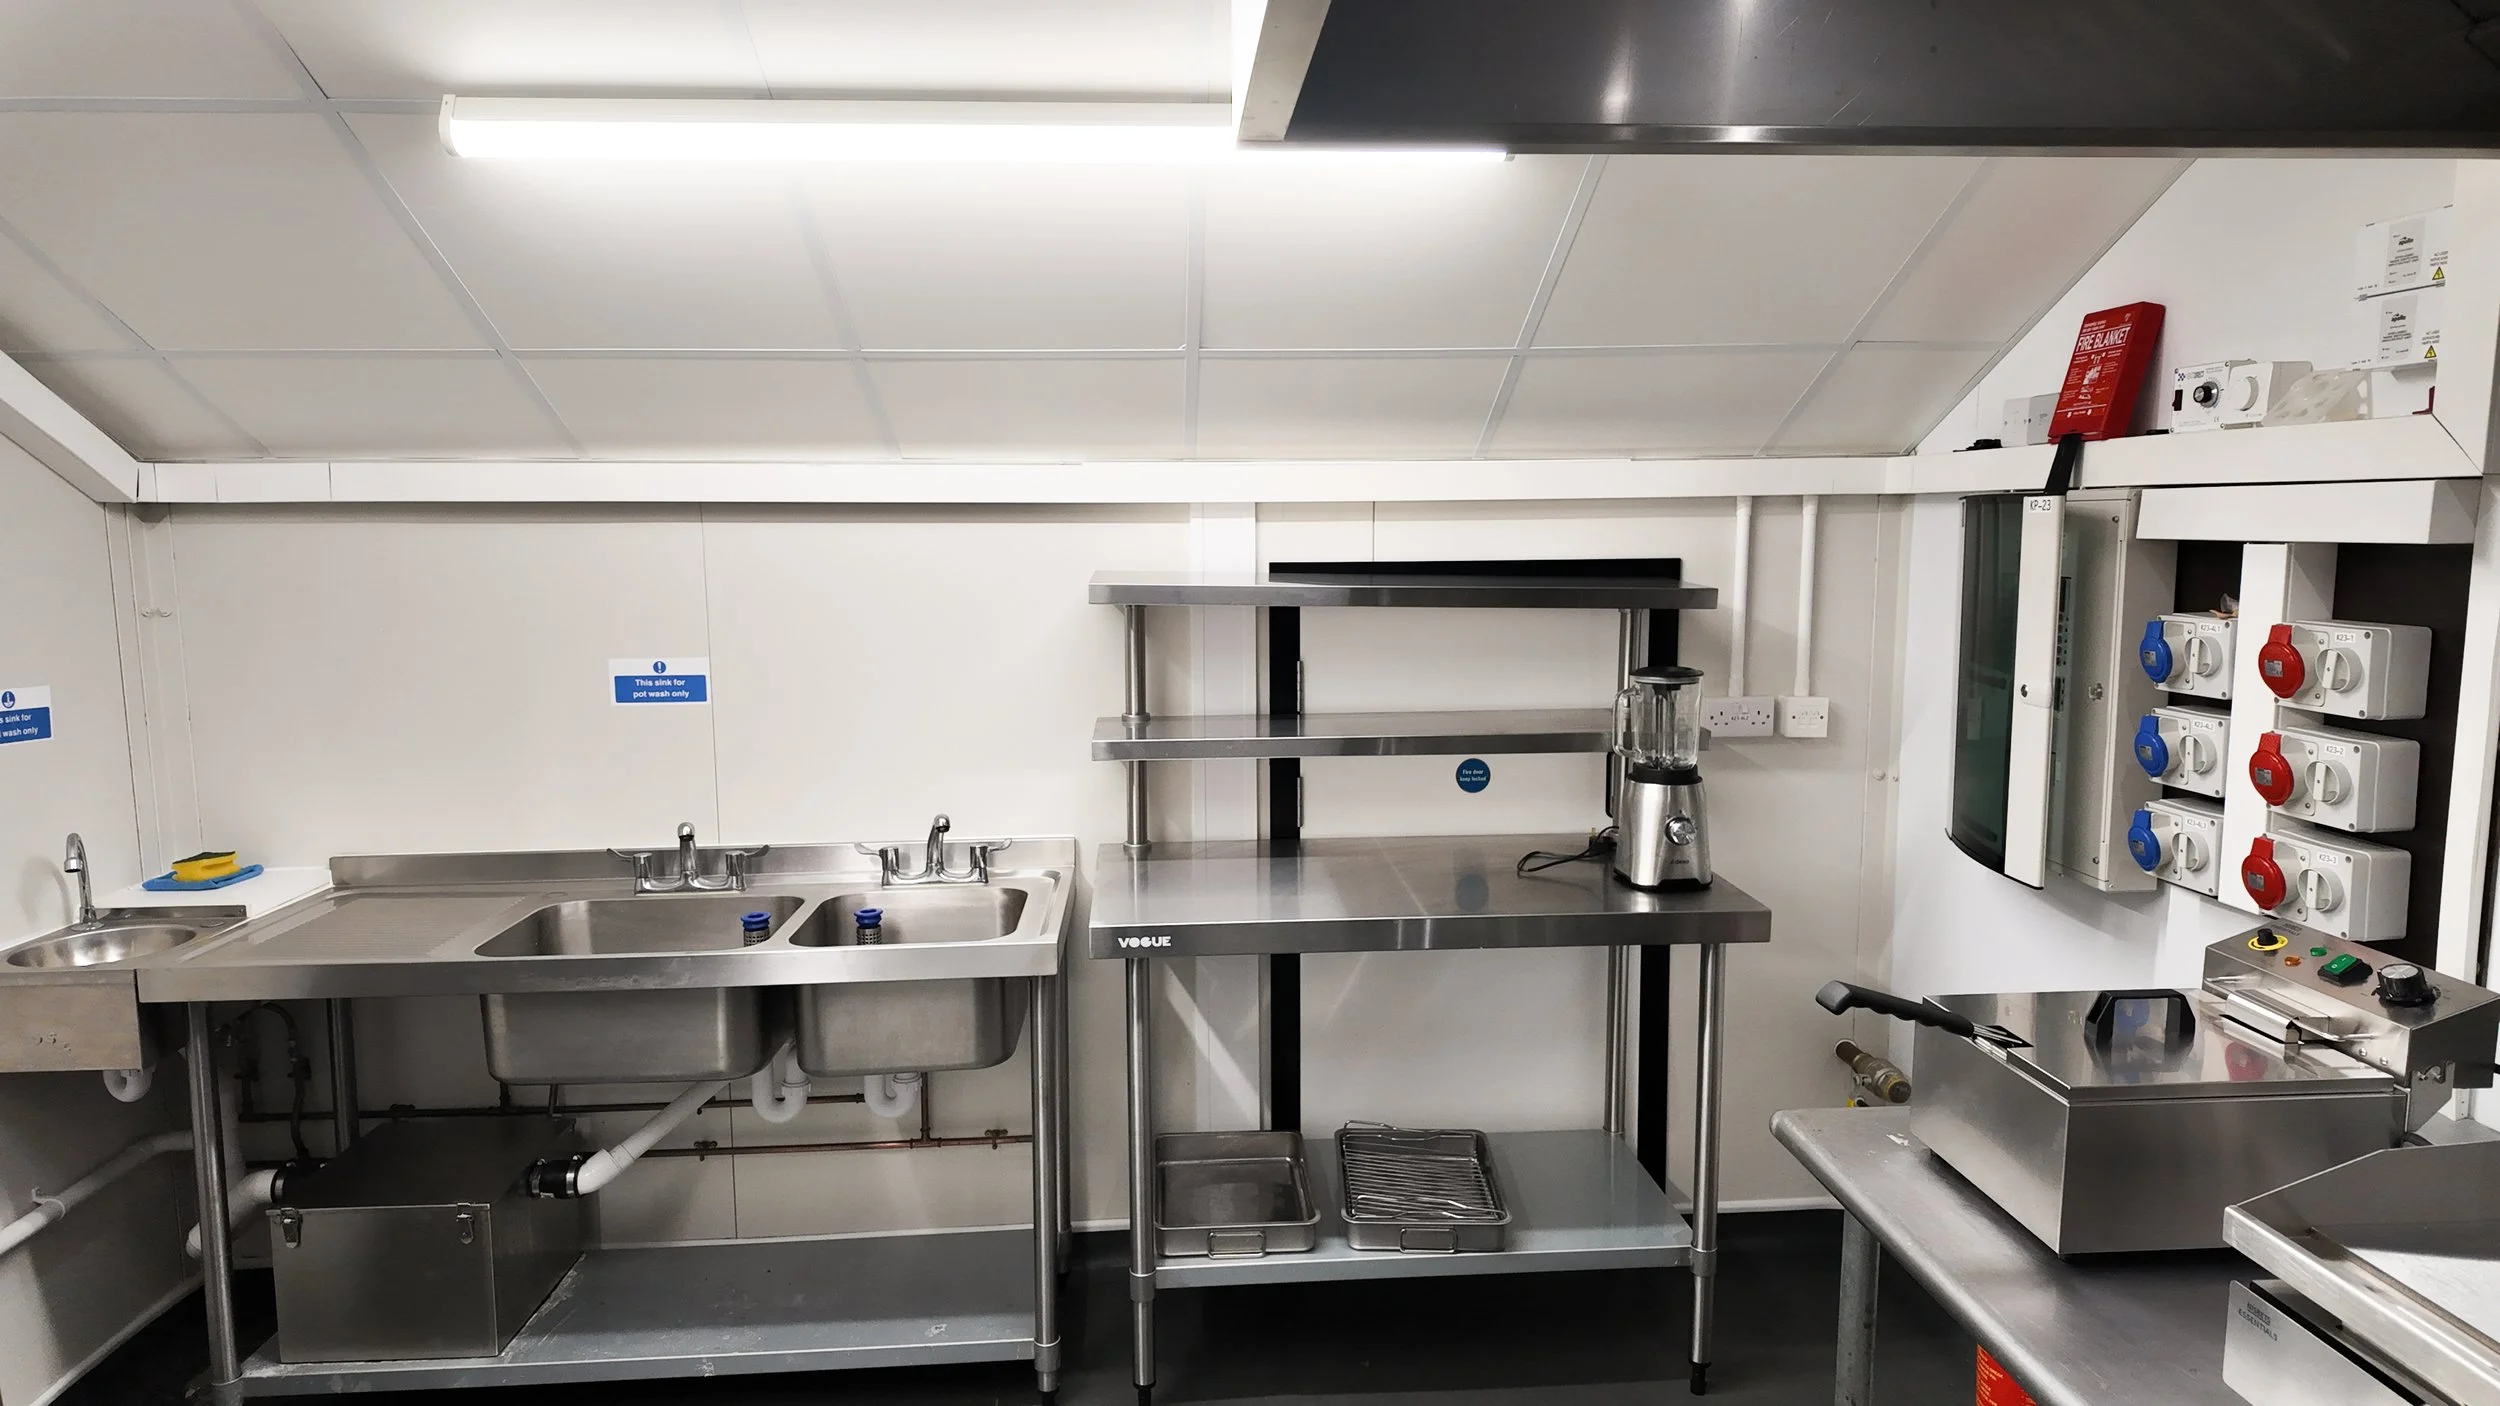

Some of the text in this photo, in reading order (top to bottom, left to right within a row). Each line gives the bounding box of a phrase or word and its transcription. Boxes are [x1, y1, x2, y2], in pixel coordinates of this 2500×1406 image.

[2075, 333, 2096, 352] FIRE
[2093, 326, 2131, 349] BLANKET
[2030, 499, 2051, 511] KP-23
[673, 678, 686, 686] for
[632, 690, 690, 699] pot wash only
[5, 714, 21, 724] sink
[21, 713, 32, 722] for
[2, 728, 22, 737] wash
[22, 726, 39, 736] only
[1117, 936, 1172, 949] VOGUE
